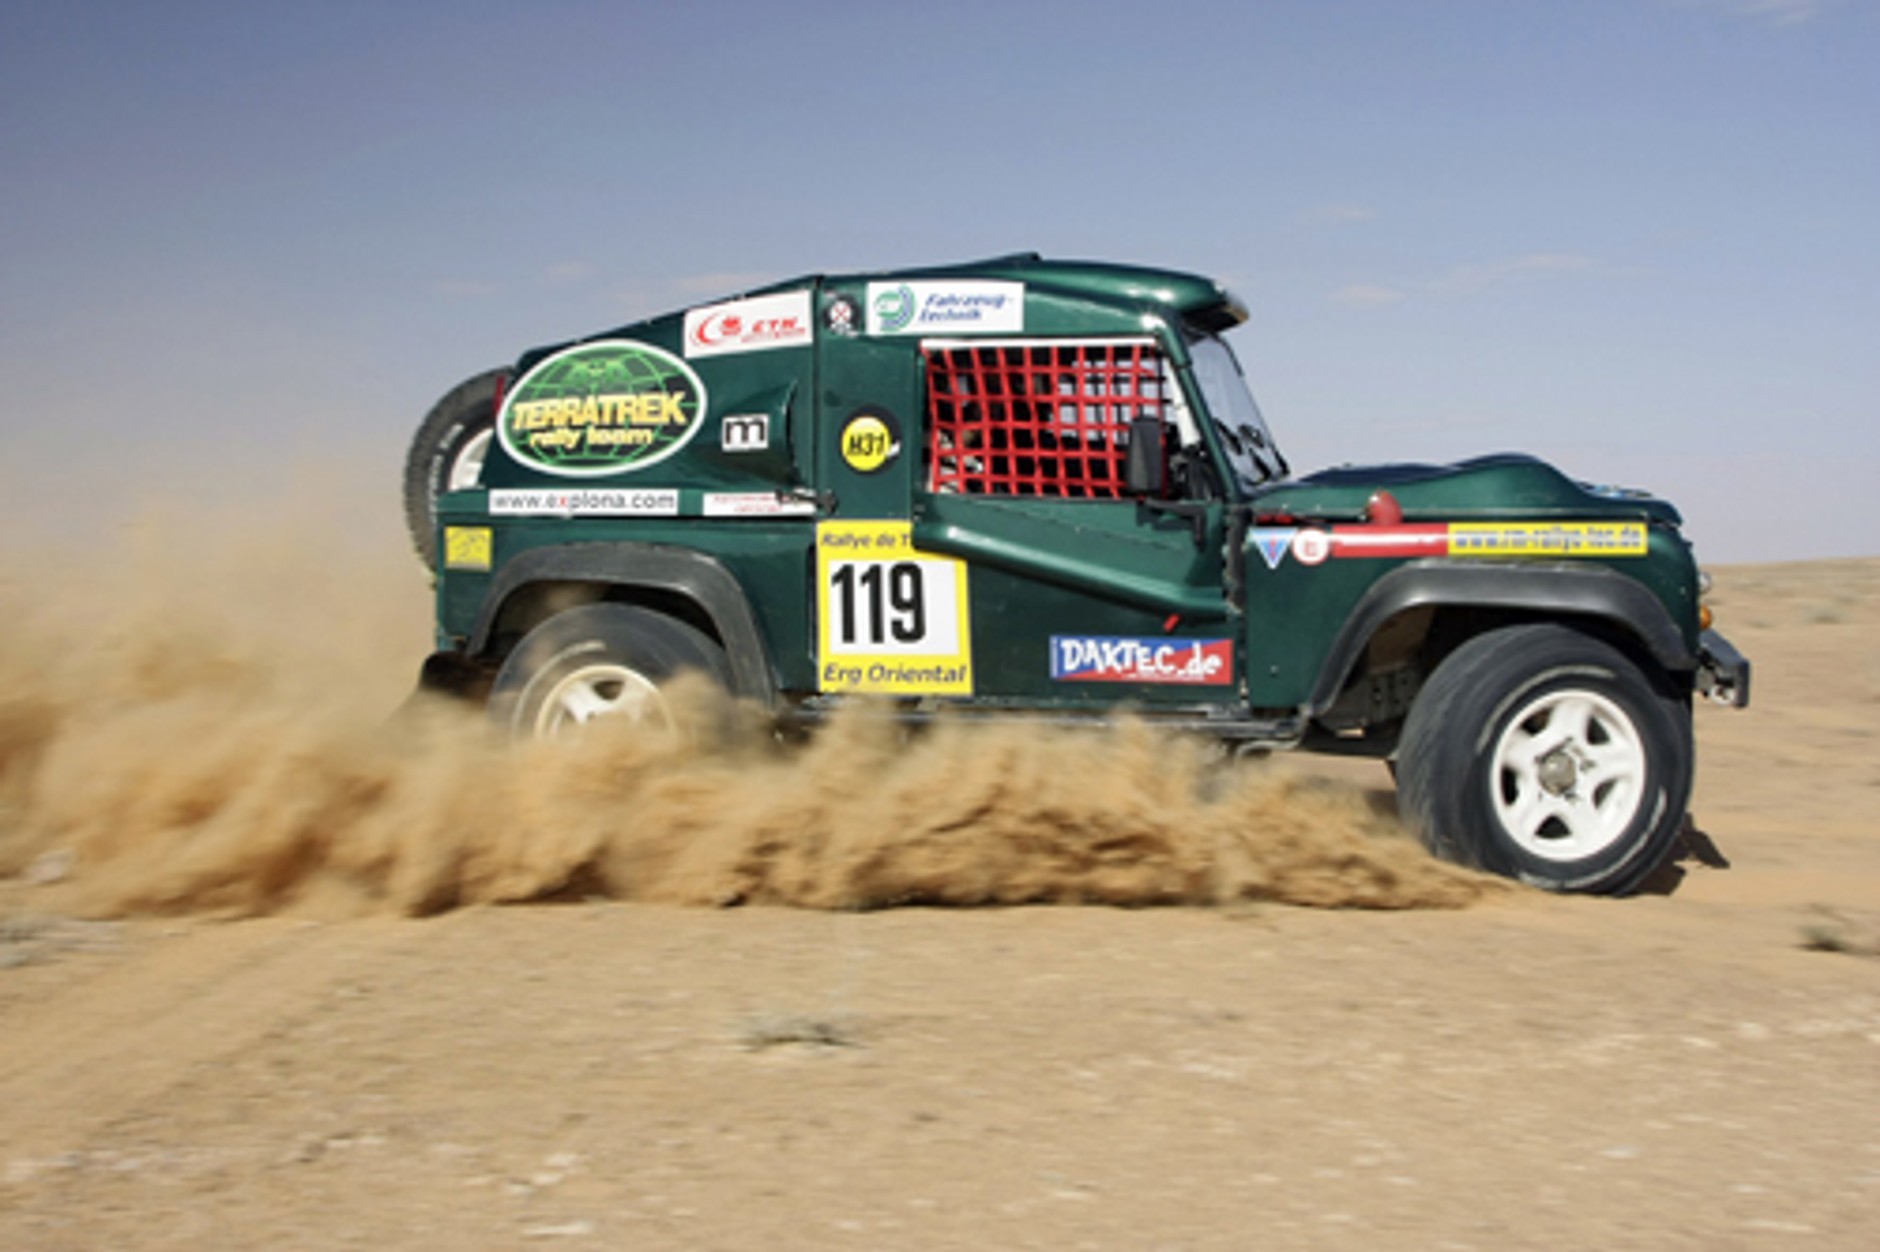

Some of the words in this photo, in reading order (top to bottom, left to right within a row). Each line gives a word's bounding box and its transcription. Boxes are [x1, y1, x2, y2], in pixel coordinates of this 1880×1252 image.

[513, 392, 687, 430] TERRATREK
[529, 427, 581, 449] rally
[586, 425, 653, 445] team
[820, 532, 872, 549] Rallye
[876, 533, 896, 546] de
[831, 561, 927, 645] 119
[823, 662, 863, 685] Erg
[868, 664, 968, 684] Oriental
